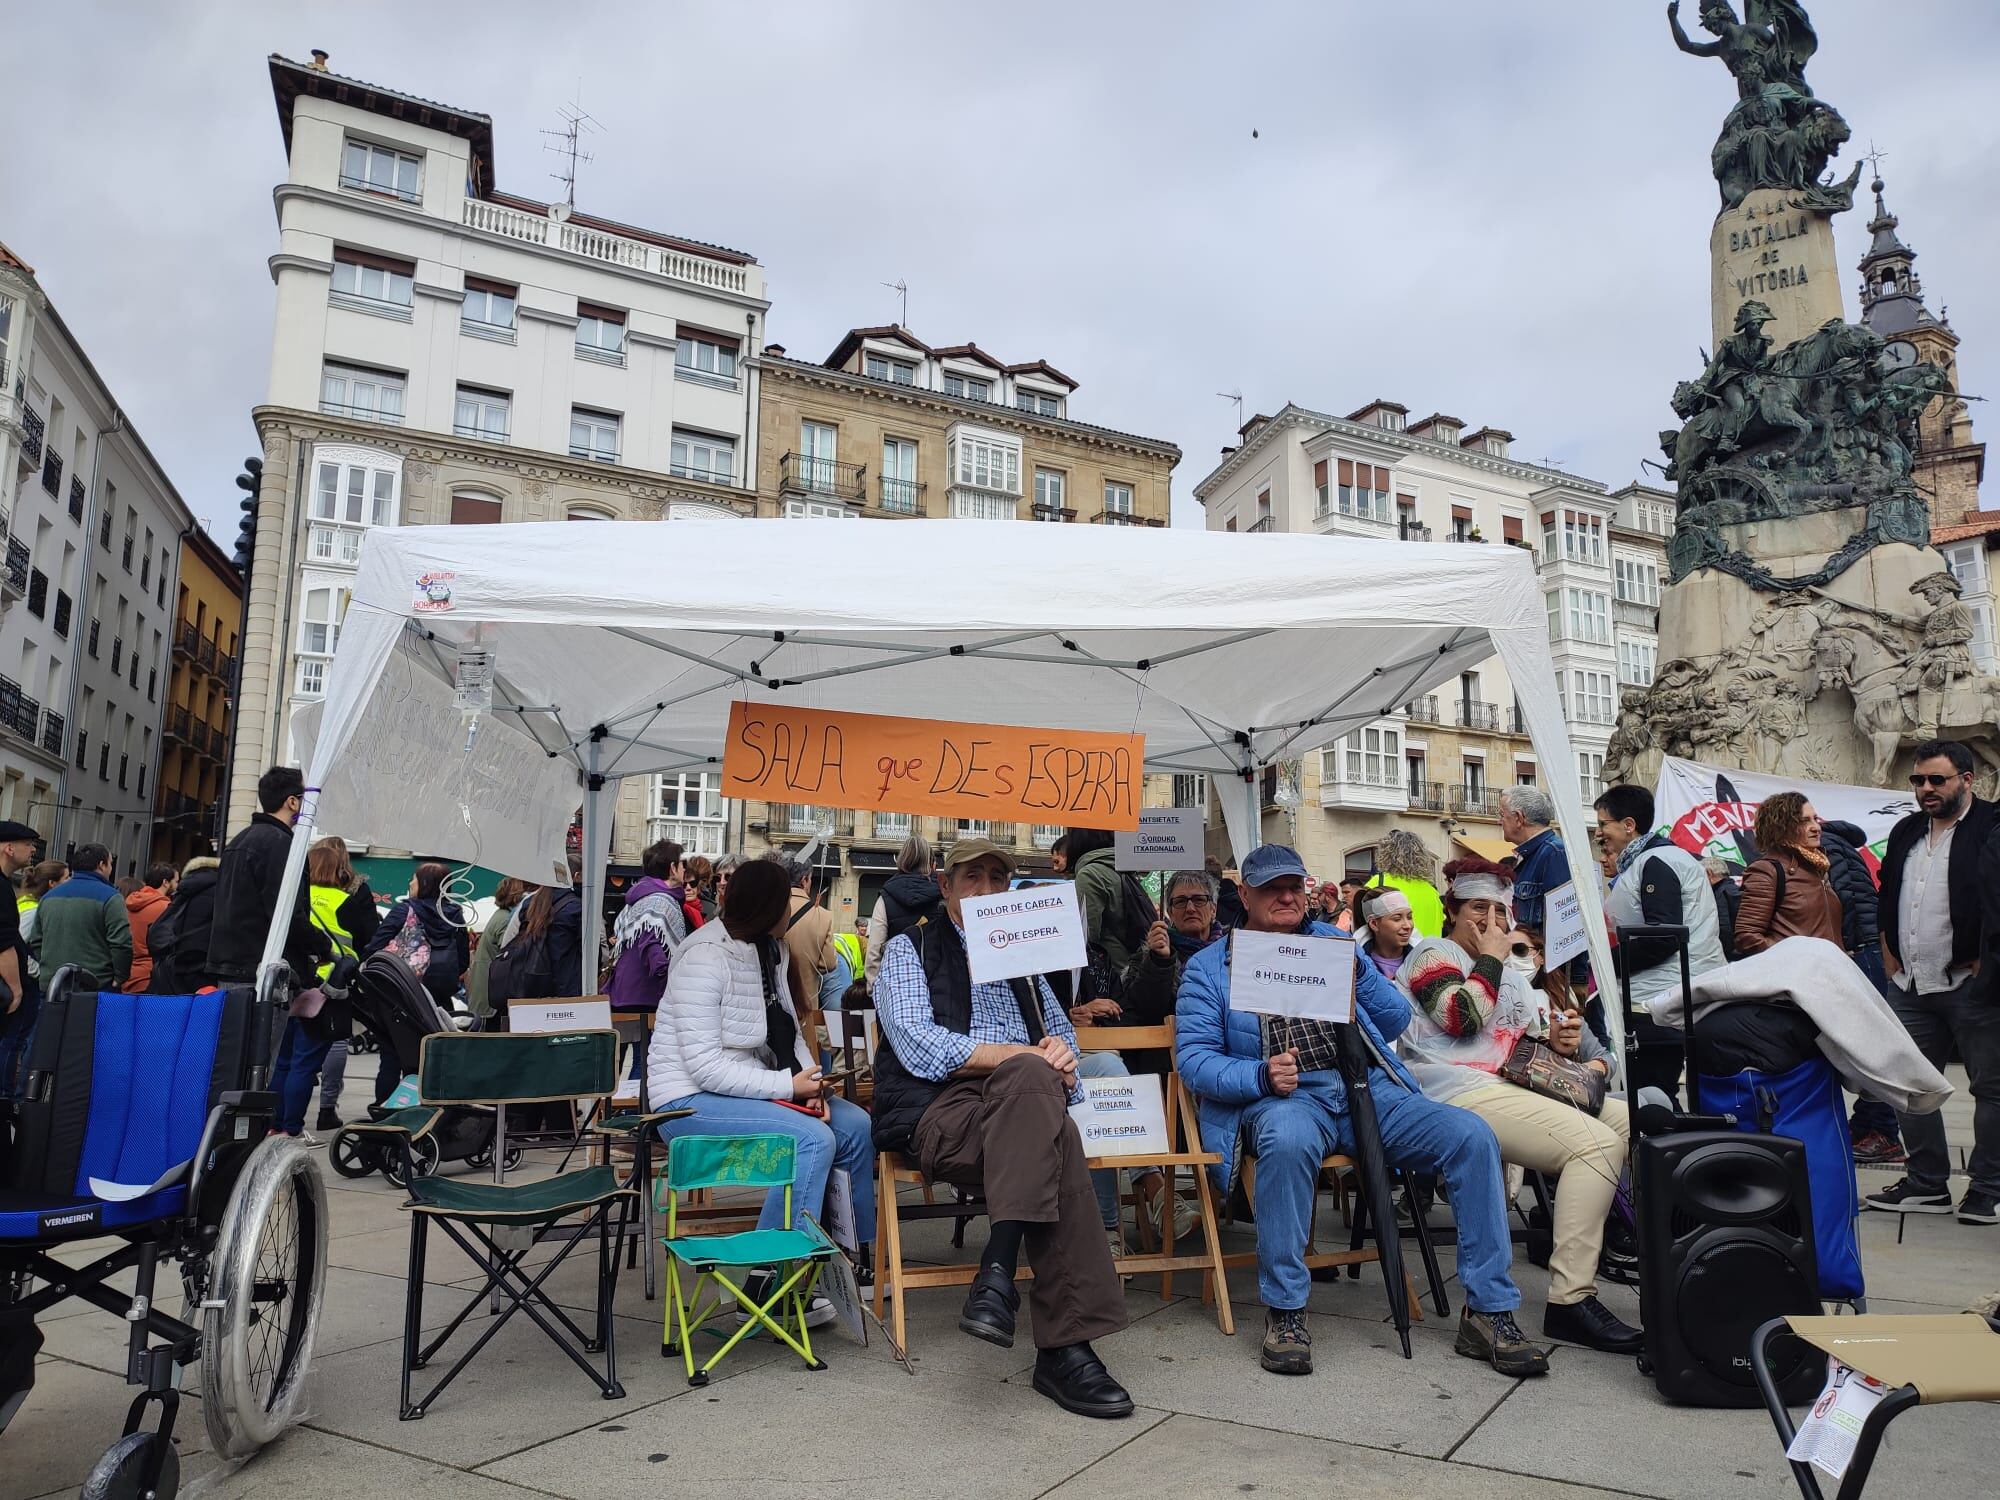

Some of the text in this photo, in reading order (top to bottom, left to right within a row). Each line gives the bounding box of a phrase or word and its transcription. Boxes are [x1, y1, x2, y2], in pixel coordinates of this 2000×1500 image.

[1746, 201, 1785, 221] A LA
[1730, 215, 1808, 252] BATALLA
[1762, 249, 1779, 266] DE
[1737, 264, 1808, 297] VITORIA
[732, 721, 846, 794] SALA
[877, 756, 923, 802] que
[1147, 835, 1176, 843] ORDUKO
[1133, 845, 1185, 853] ITXARONALDIA
[977, 897, 1064, 918] DOLOR DE CABEZA
[990, 926, 1059, 944] 6 H DE ESPERA
[1278, 946, 1308, 957] GRIPE
[1255, 970, 1327, 986] 8 H DE ESPERA
[546, 1011, 575, 1019] FIEBRE
[1089, 1086, 1134, 1098] INFECCIÓN
[1093, 1100, 1133, 1110] URINARIA
[1087, 1125, 1146, 1136] 5 H DE ESPERA
[44, 1212, 94, 1227] VERMEIREN
